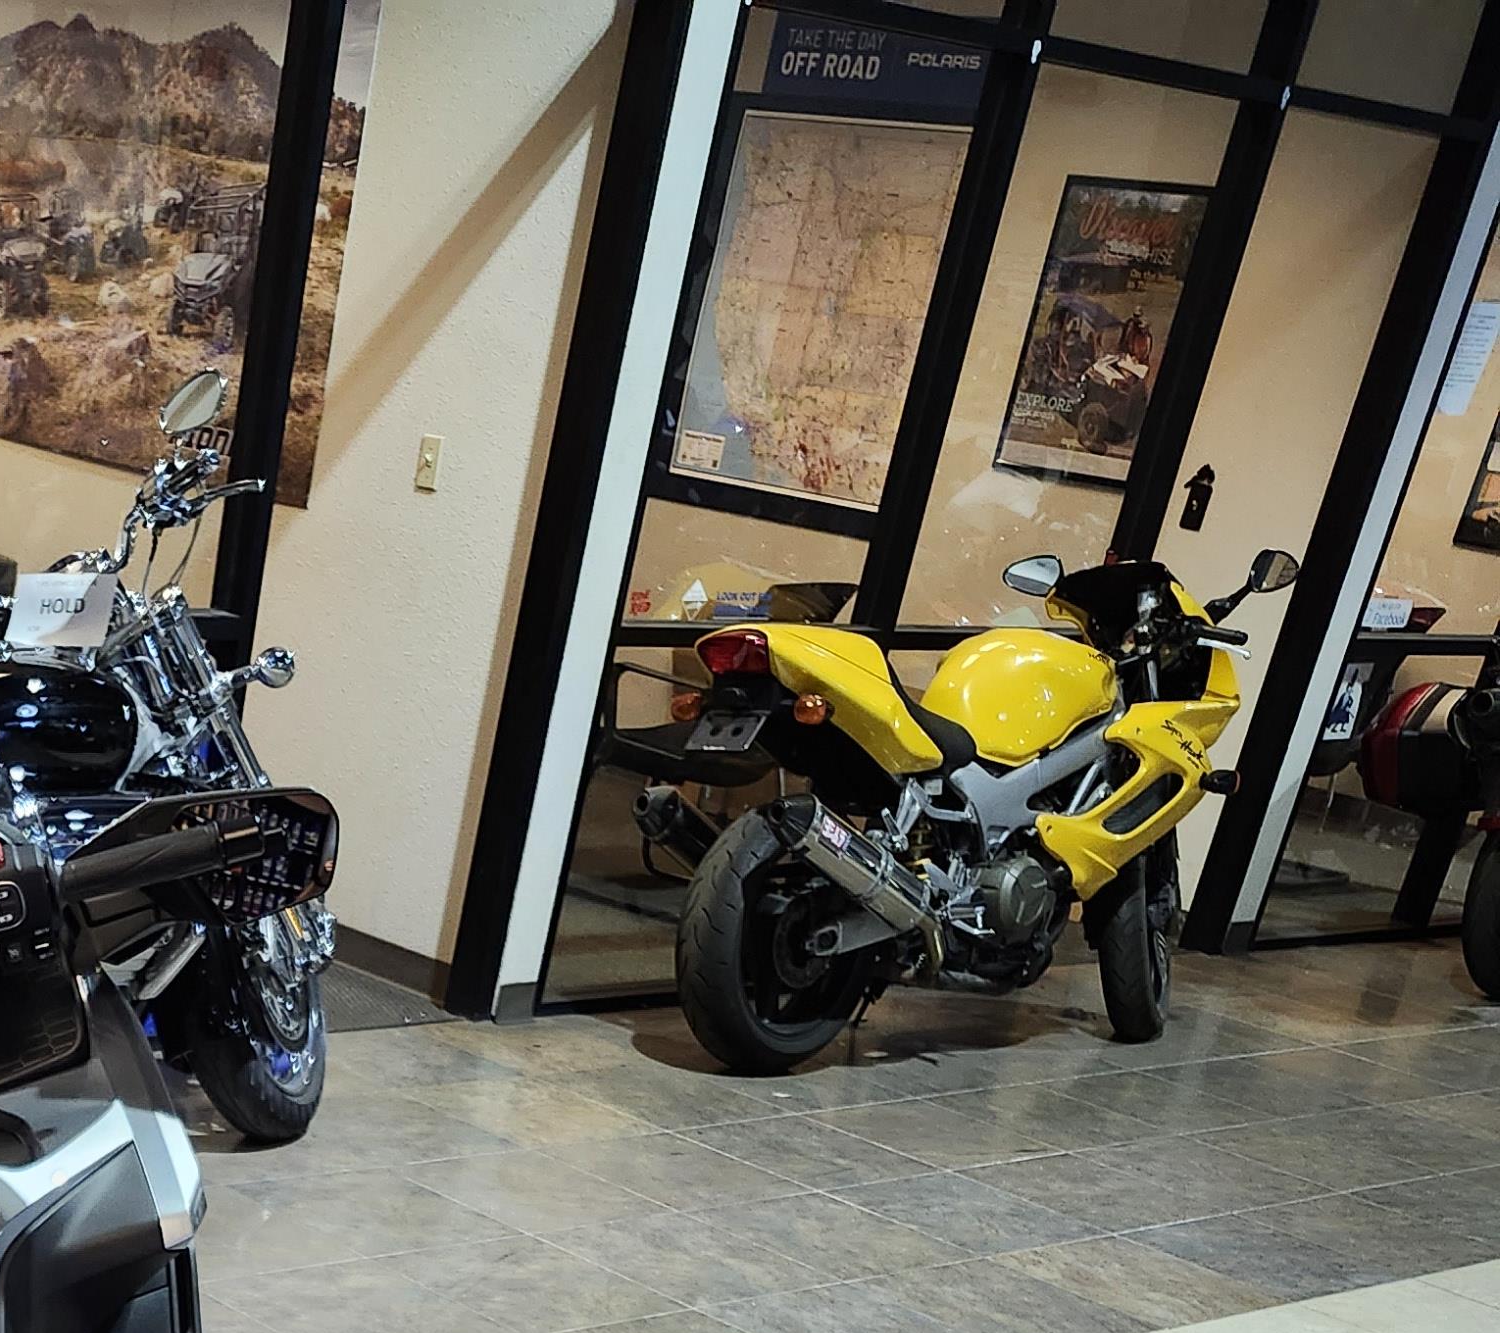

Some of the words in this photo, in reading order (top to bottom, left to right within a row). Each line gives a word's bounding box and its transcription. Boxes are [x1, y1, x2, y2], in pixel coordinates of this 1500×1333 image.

[788, 28, 823, 48] TAKE
[827, 29, 854, 49] THE
[856, 30, 888, 51] DAY
[780, 50, 821, 77] OFF
[822, 52, 880, 80] ROAD
[907, 52, 981, 70] POLARIS
[1015, 391, 1073, 413] EXPLORE
[39, 598, 85, 615] HOLD
